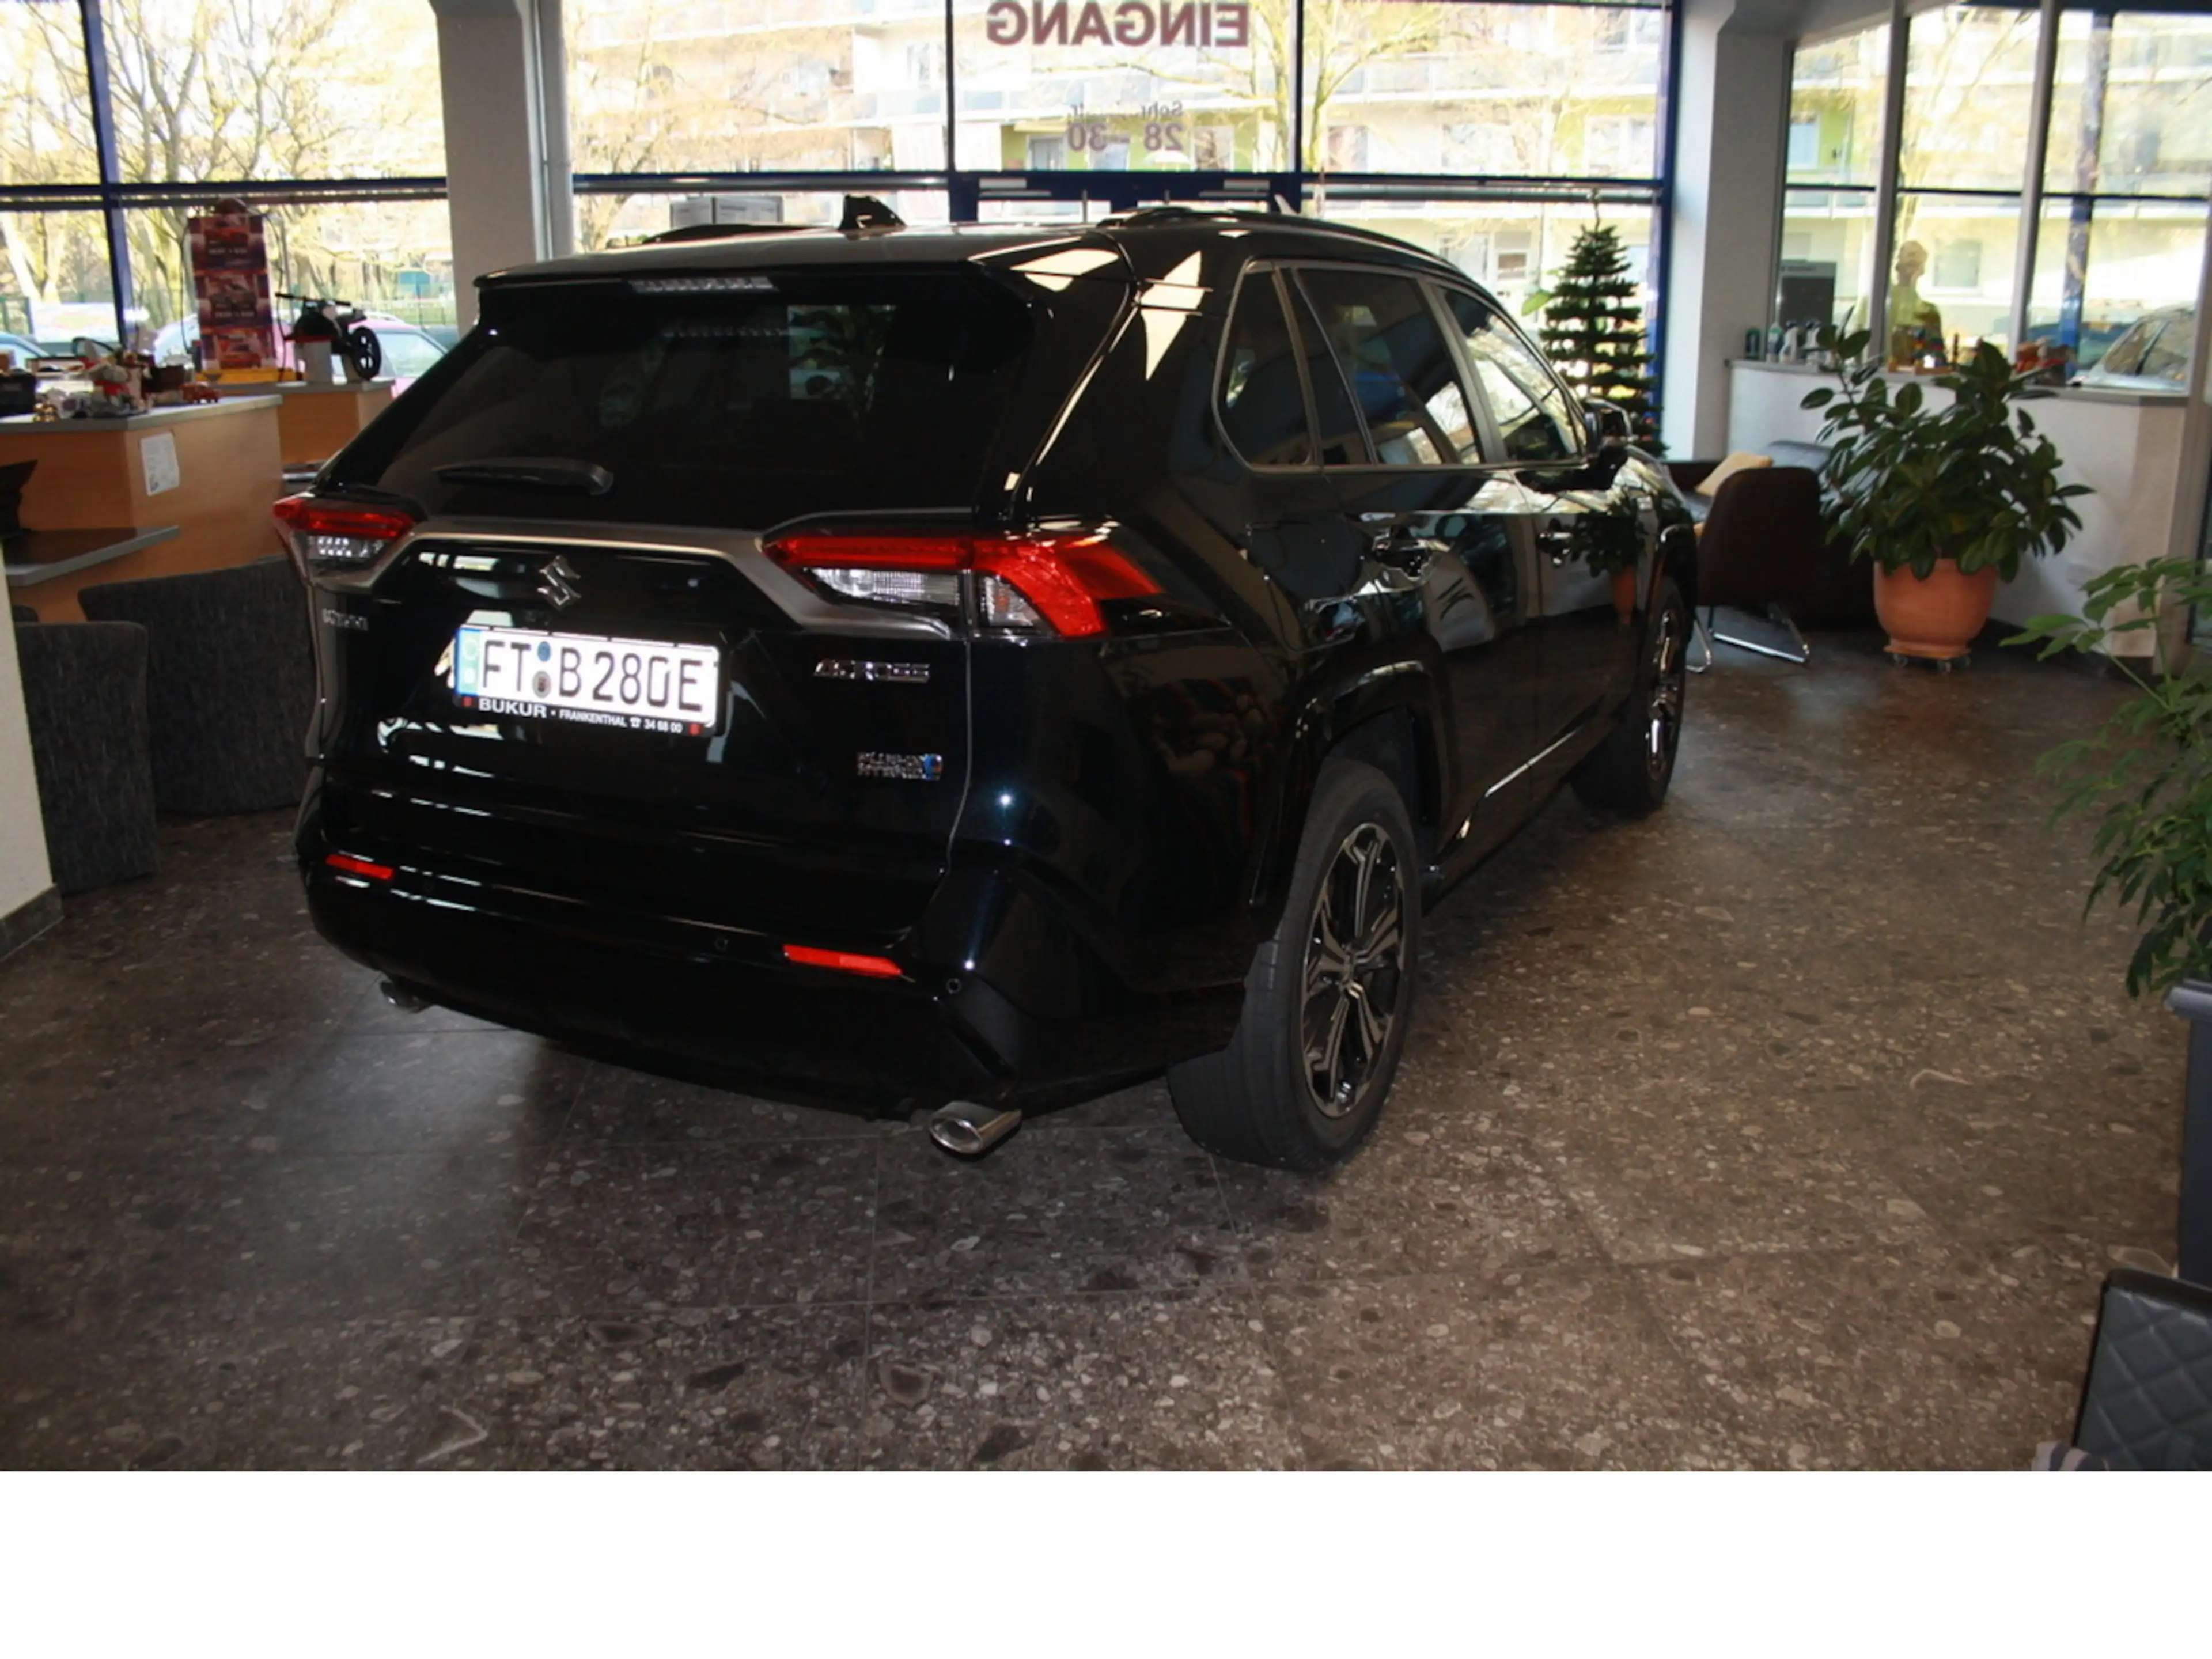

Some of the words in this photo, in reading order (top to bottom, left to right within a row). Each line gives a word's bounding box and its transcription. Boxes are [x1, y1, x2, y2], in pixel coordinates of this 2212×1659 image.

[482, 639, 531, 691] FT
[559, 647, 582, 698] B
[592, 651, 702, 712] 280E
[479, 698, 547, 719] BUKUR
[559, 709, 627, 728] FRANKENTHAL
